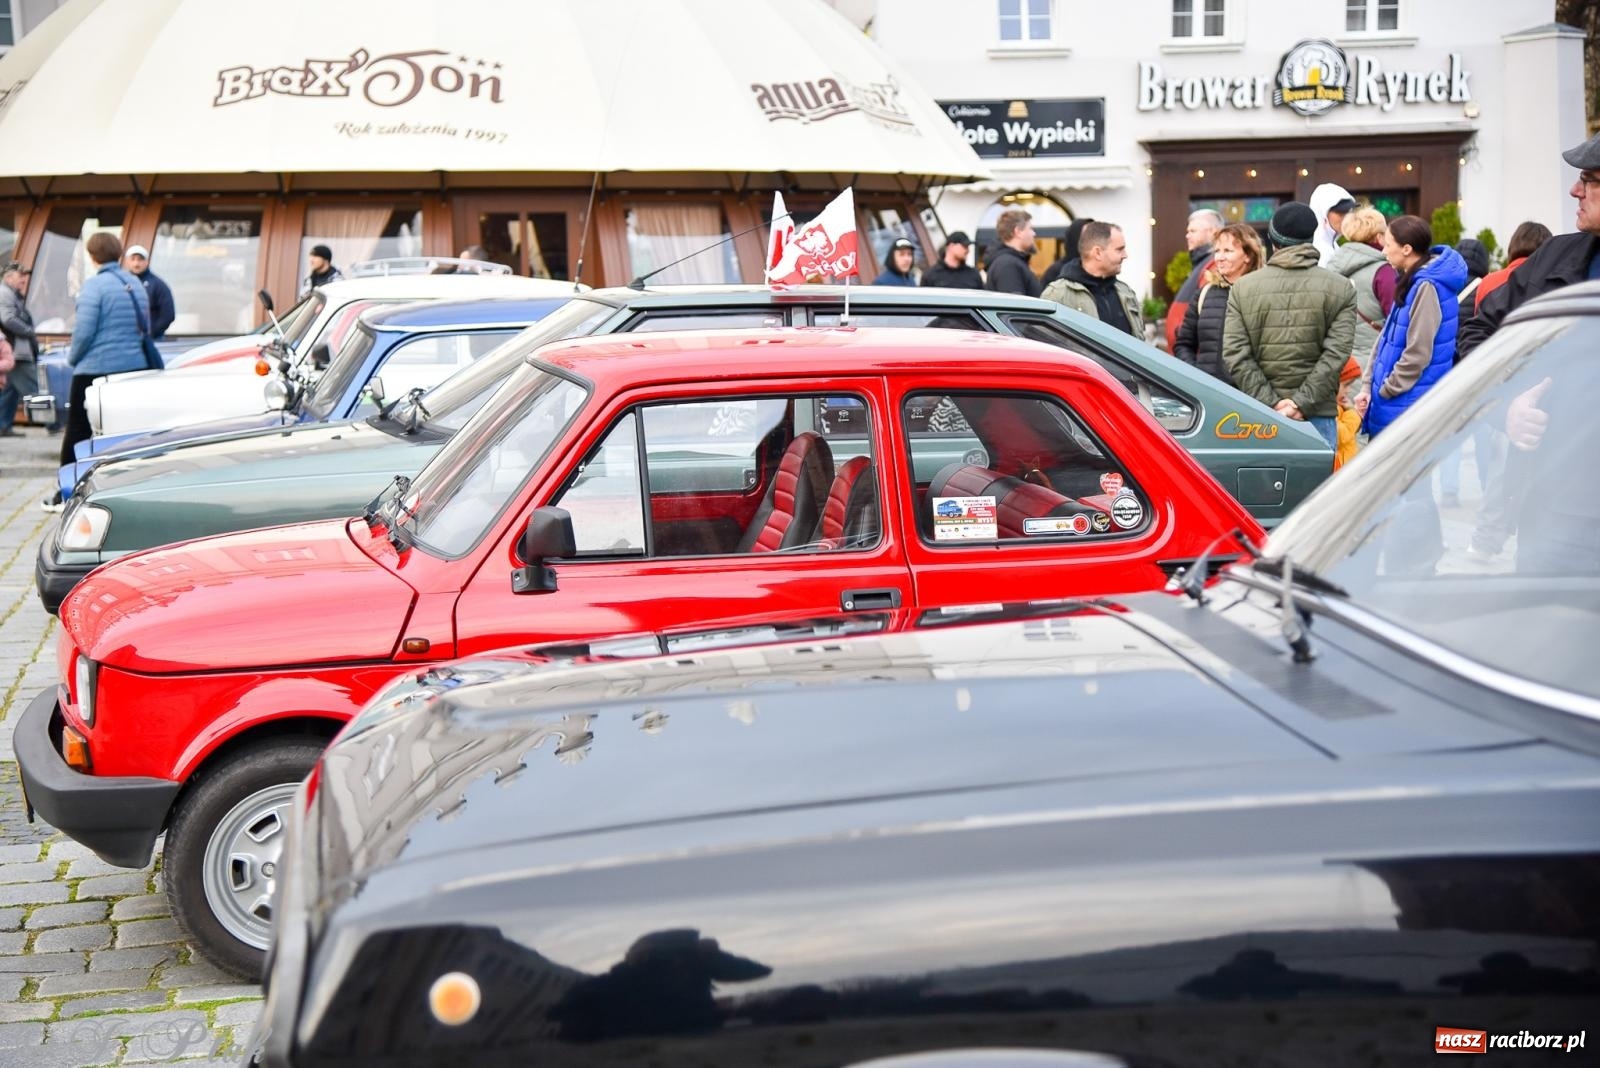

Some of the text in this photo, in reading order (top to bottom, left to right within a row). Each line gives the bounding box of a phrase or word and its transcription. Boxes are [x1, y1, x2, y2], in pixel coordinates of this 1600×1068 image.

[1138, 53, 1473, 112] Browar Rynek
[334, 121, 509, 143] Rok założenia 1997
[1003, 118, 1096, 149] Wypieki
